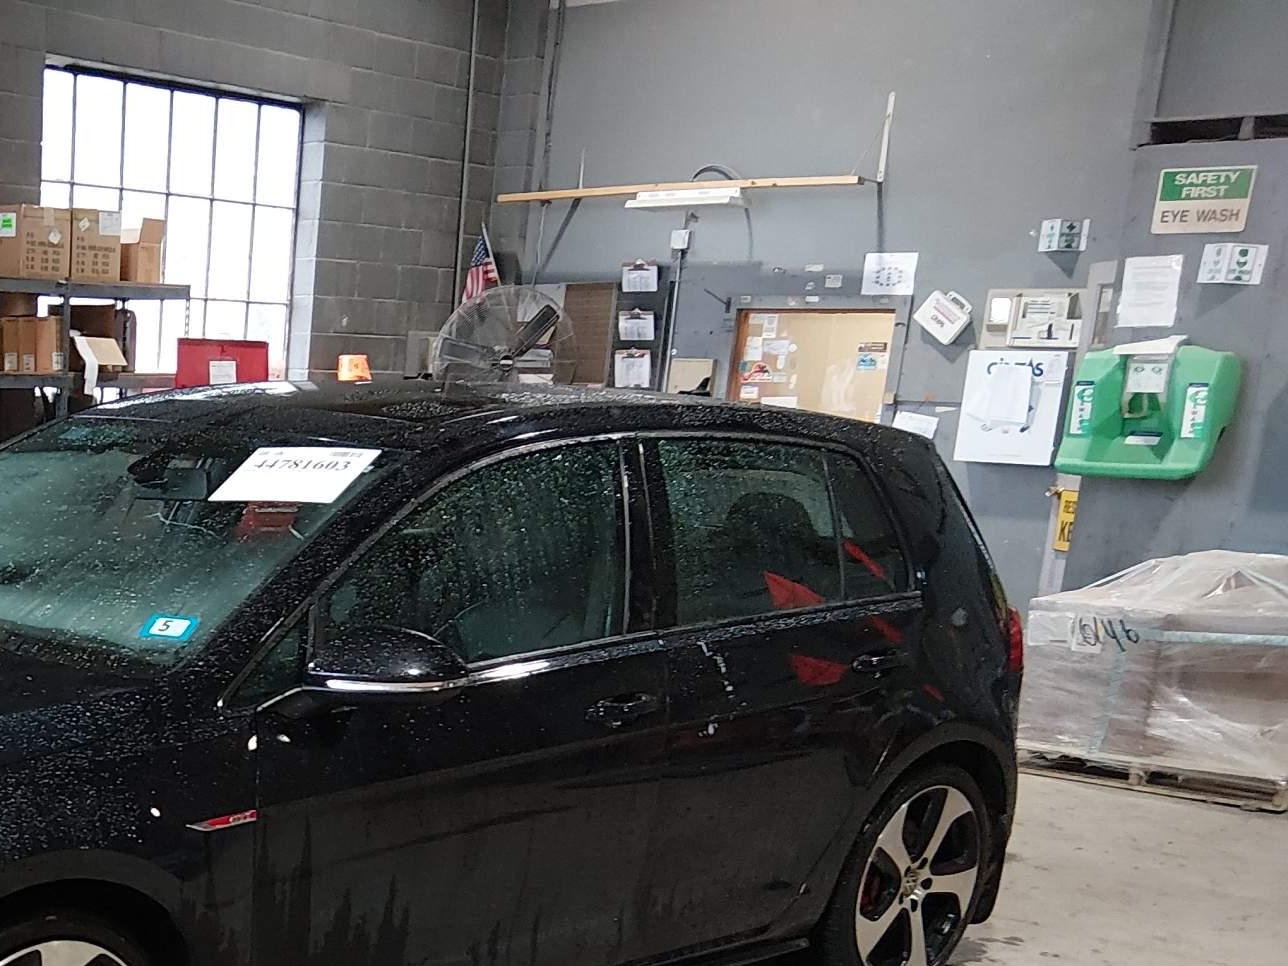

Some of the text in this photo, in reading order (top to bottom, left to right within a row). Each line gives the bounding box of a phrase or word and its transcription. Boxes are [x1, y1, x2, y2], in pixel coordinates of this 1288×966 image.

[1174, 171, 1241, 185] SAFETY
[1181, 186, 1230, 198] FIRST
[1160, 208, 1241, 223] EYE WASH
[253, 459, 352, 472] 44781603
[158, 620, 174, 631] 5
